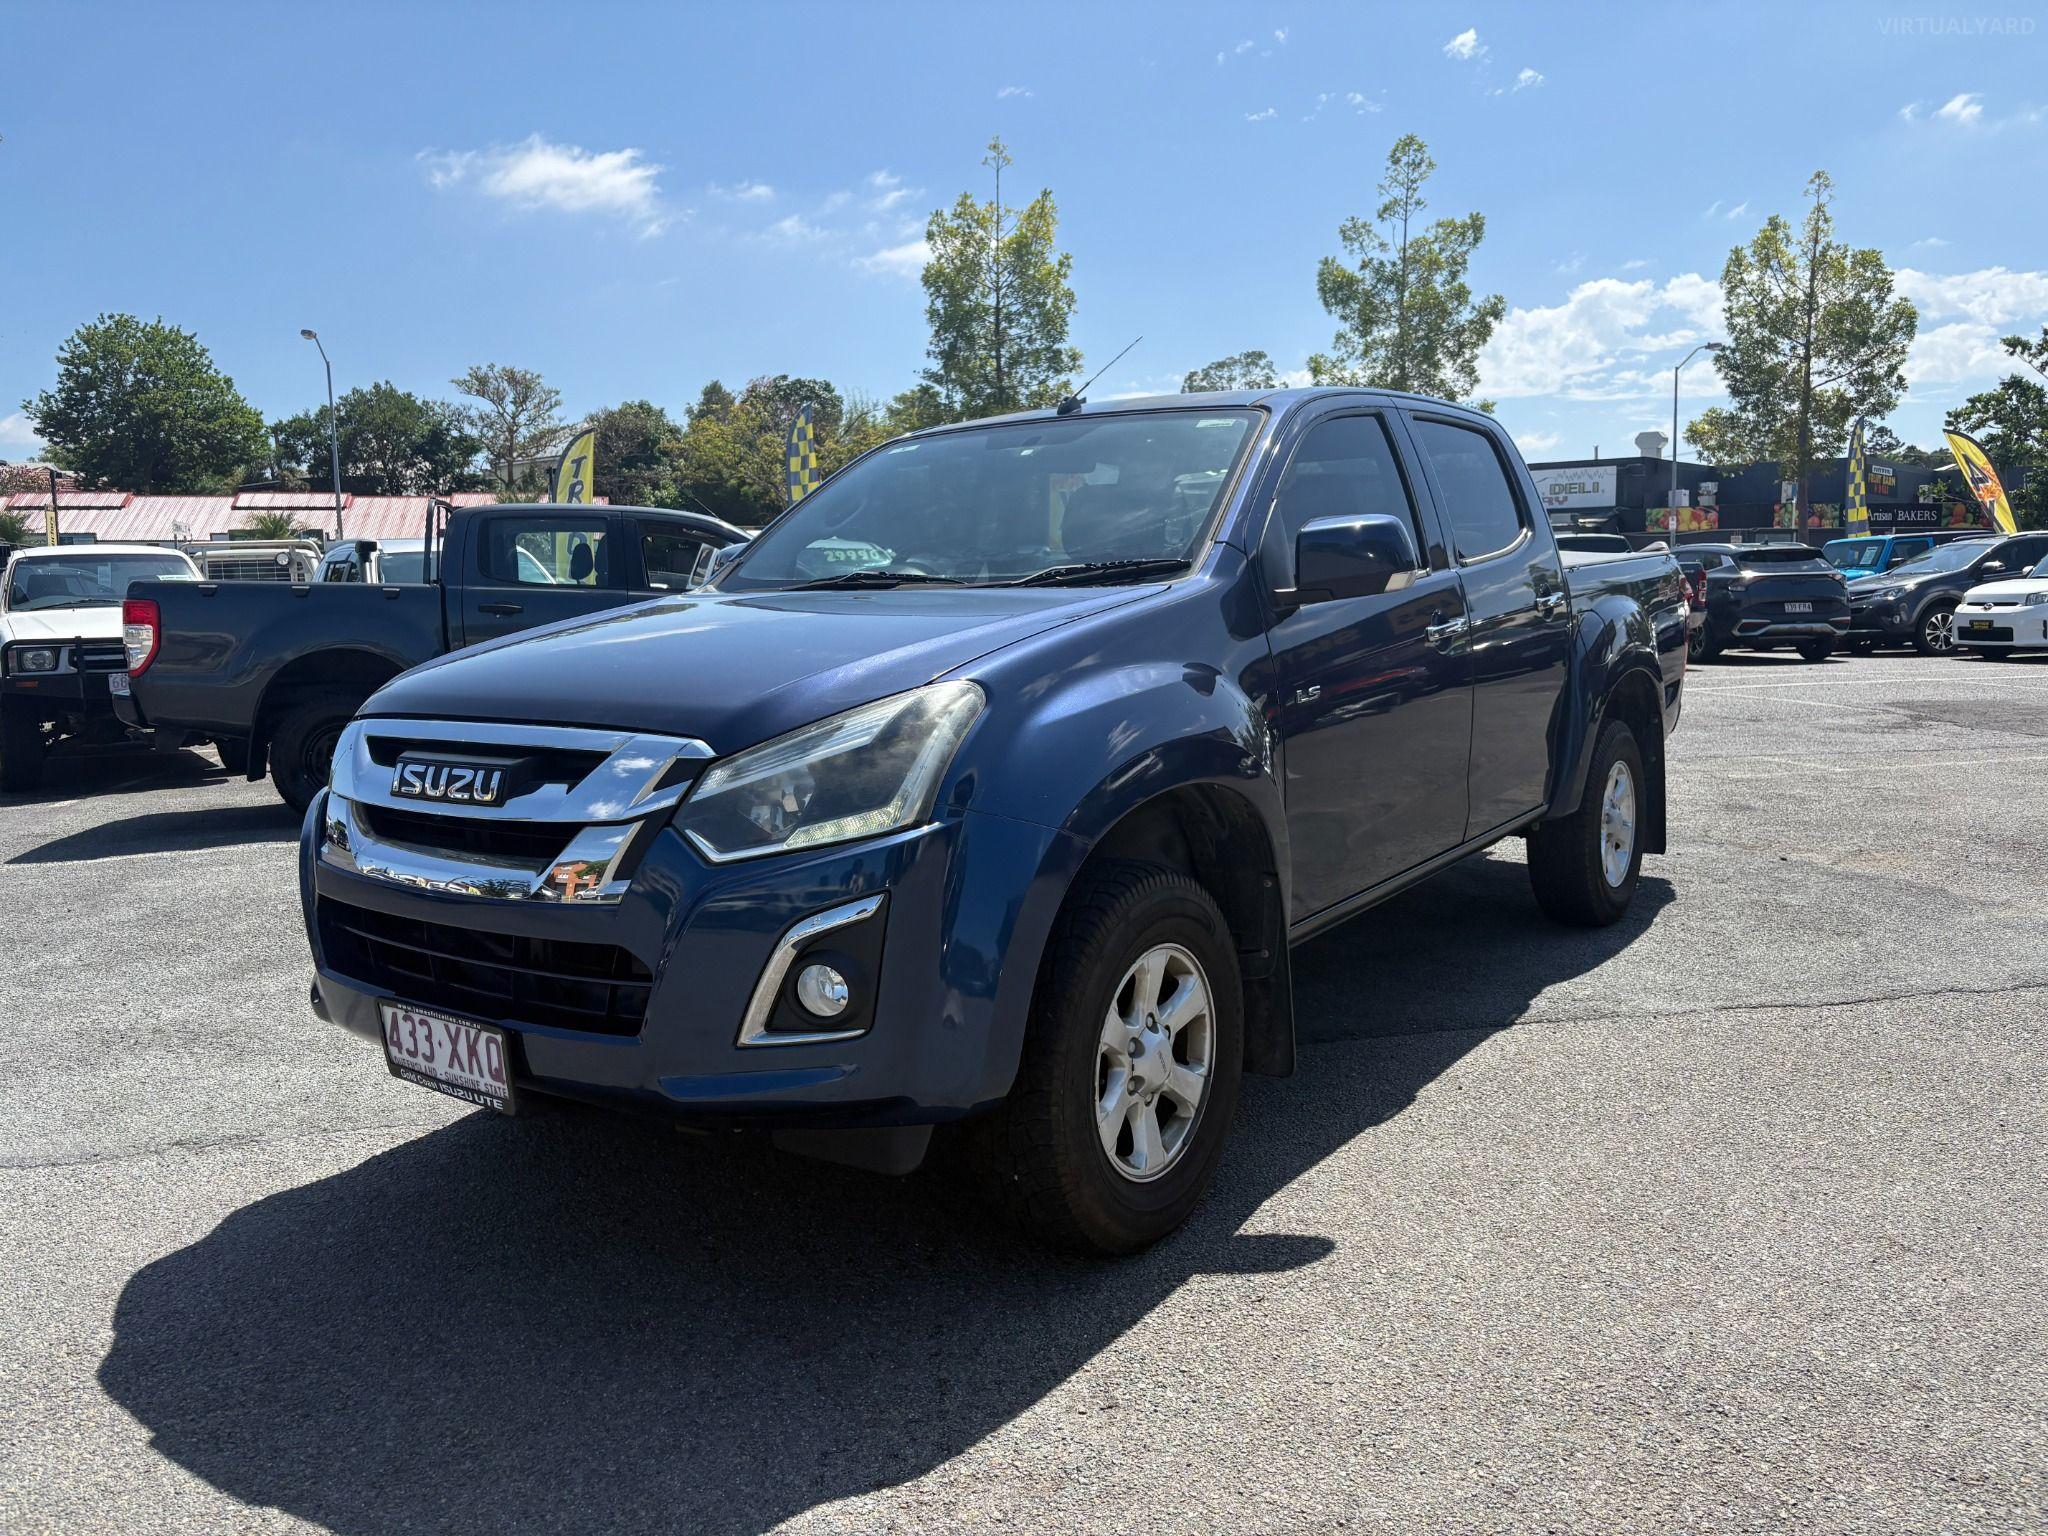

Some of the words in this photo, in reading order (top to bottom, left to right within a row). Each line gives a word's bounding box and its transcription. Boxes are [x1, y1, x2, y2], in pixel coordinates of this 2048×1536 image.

[1549, 481, 1600, 496] DELI
[1868, 509, 1893, 521] Artisan
[1897, 510, 1938, 521] BAKERS
[1296, 685, 1321, 704] LS
[392, 762, 502, 802] ISUZU
[394, 1055, 438, 1077] QUEENSLAND
[444, 1071, 481, 1092] SUNSHINE
[484, 1082, 509, 1098] STATE
[400, 1068, 417, 1081] Gold
[417, 1075, 438, 1091] Coast
[439, 1082, 473, 1101] ISUZU
[474, 1093, 504, 1110] UTE
